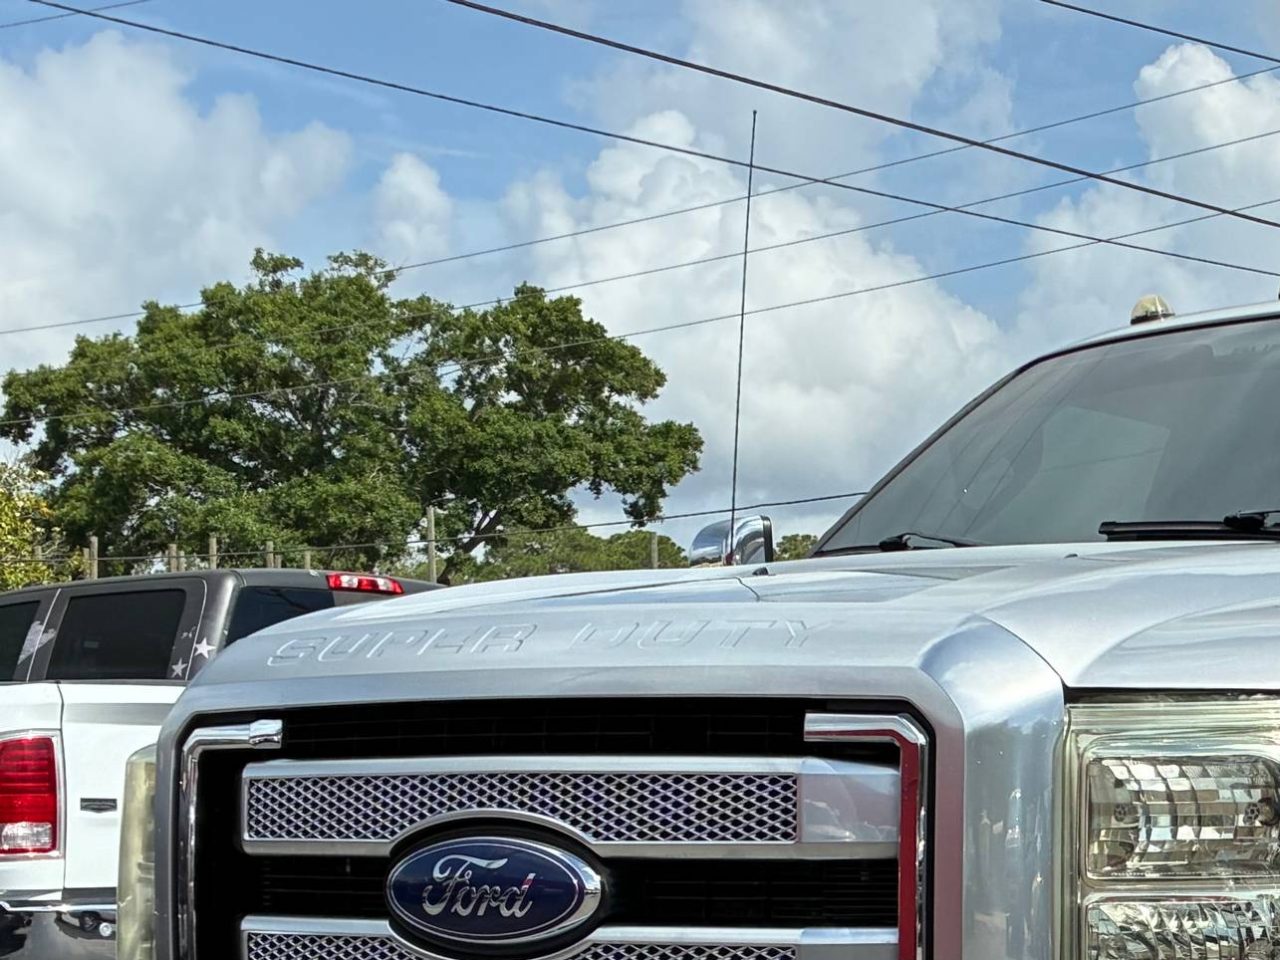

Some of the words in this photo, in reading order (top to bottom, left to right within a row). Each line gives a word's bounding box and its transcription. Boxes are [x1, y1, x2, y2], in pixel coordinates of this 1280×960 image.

[267, 623, 538, 668] SUPER
[568, 618, 826, 650] DUTY
[421, 854, 537, 919] Ford
